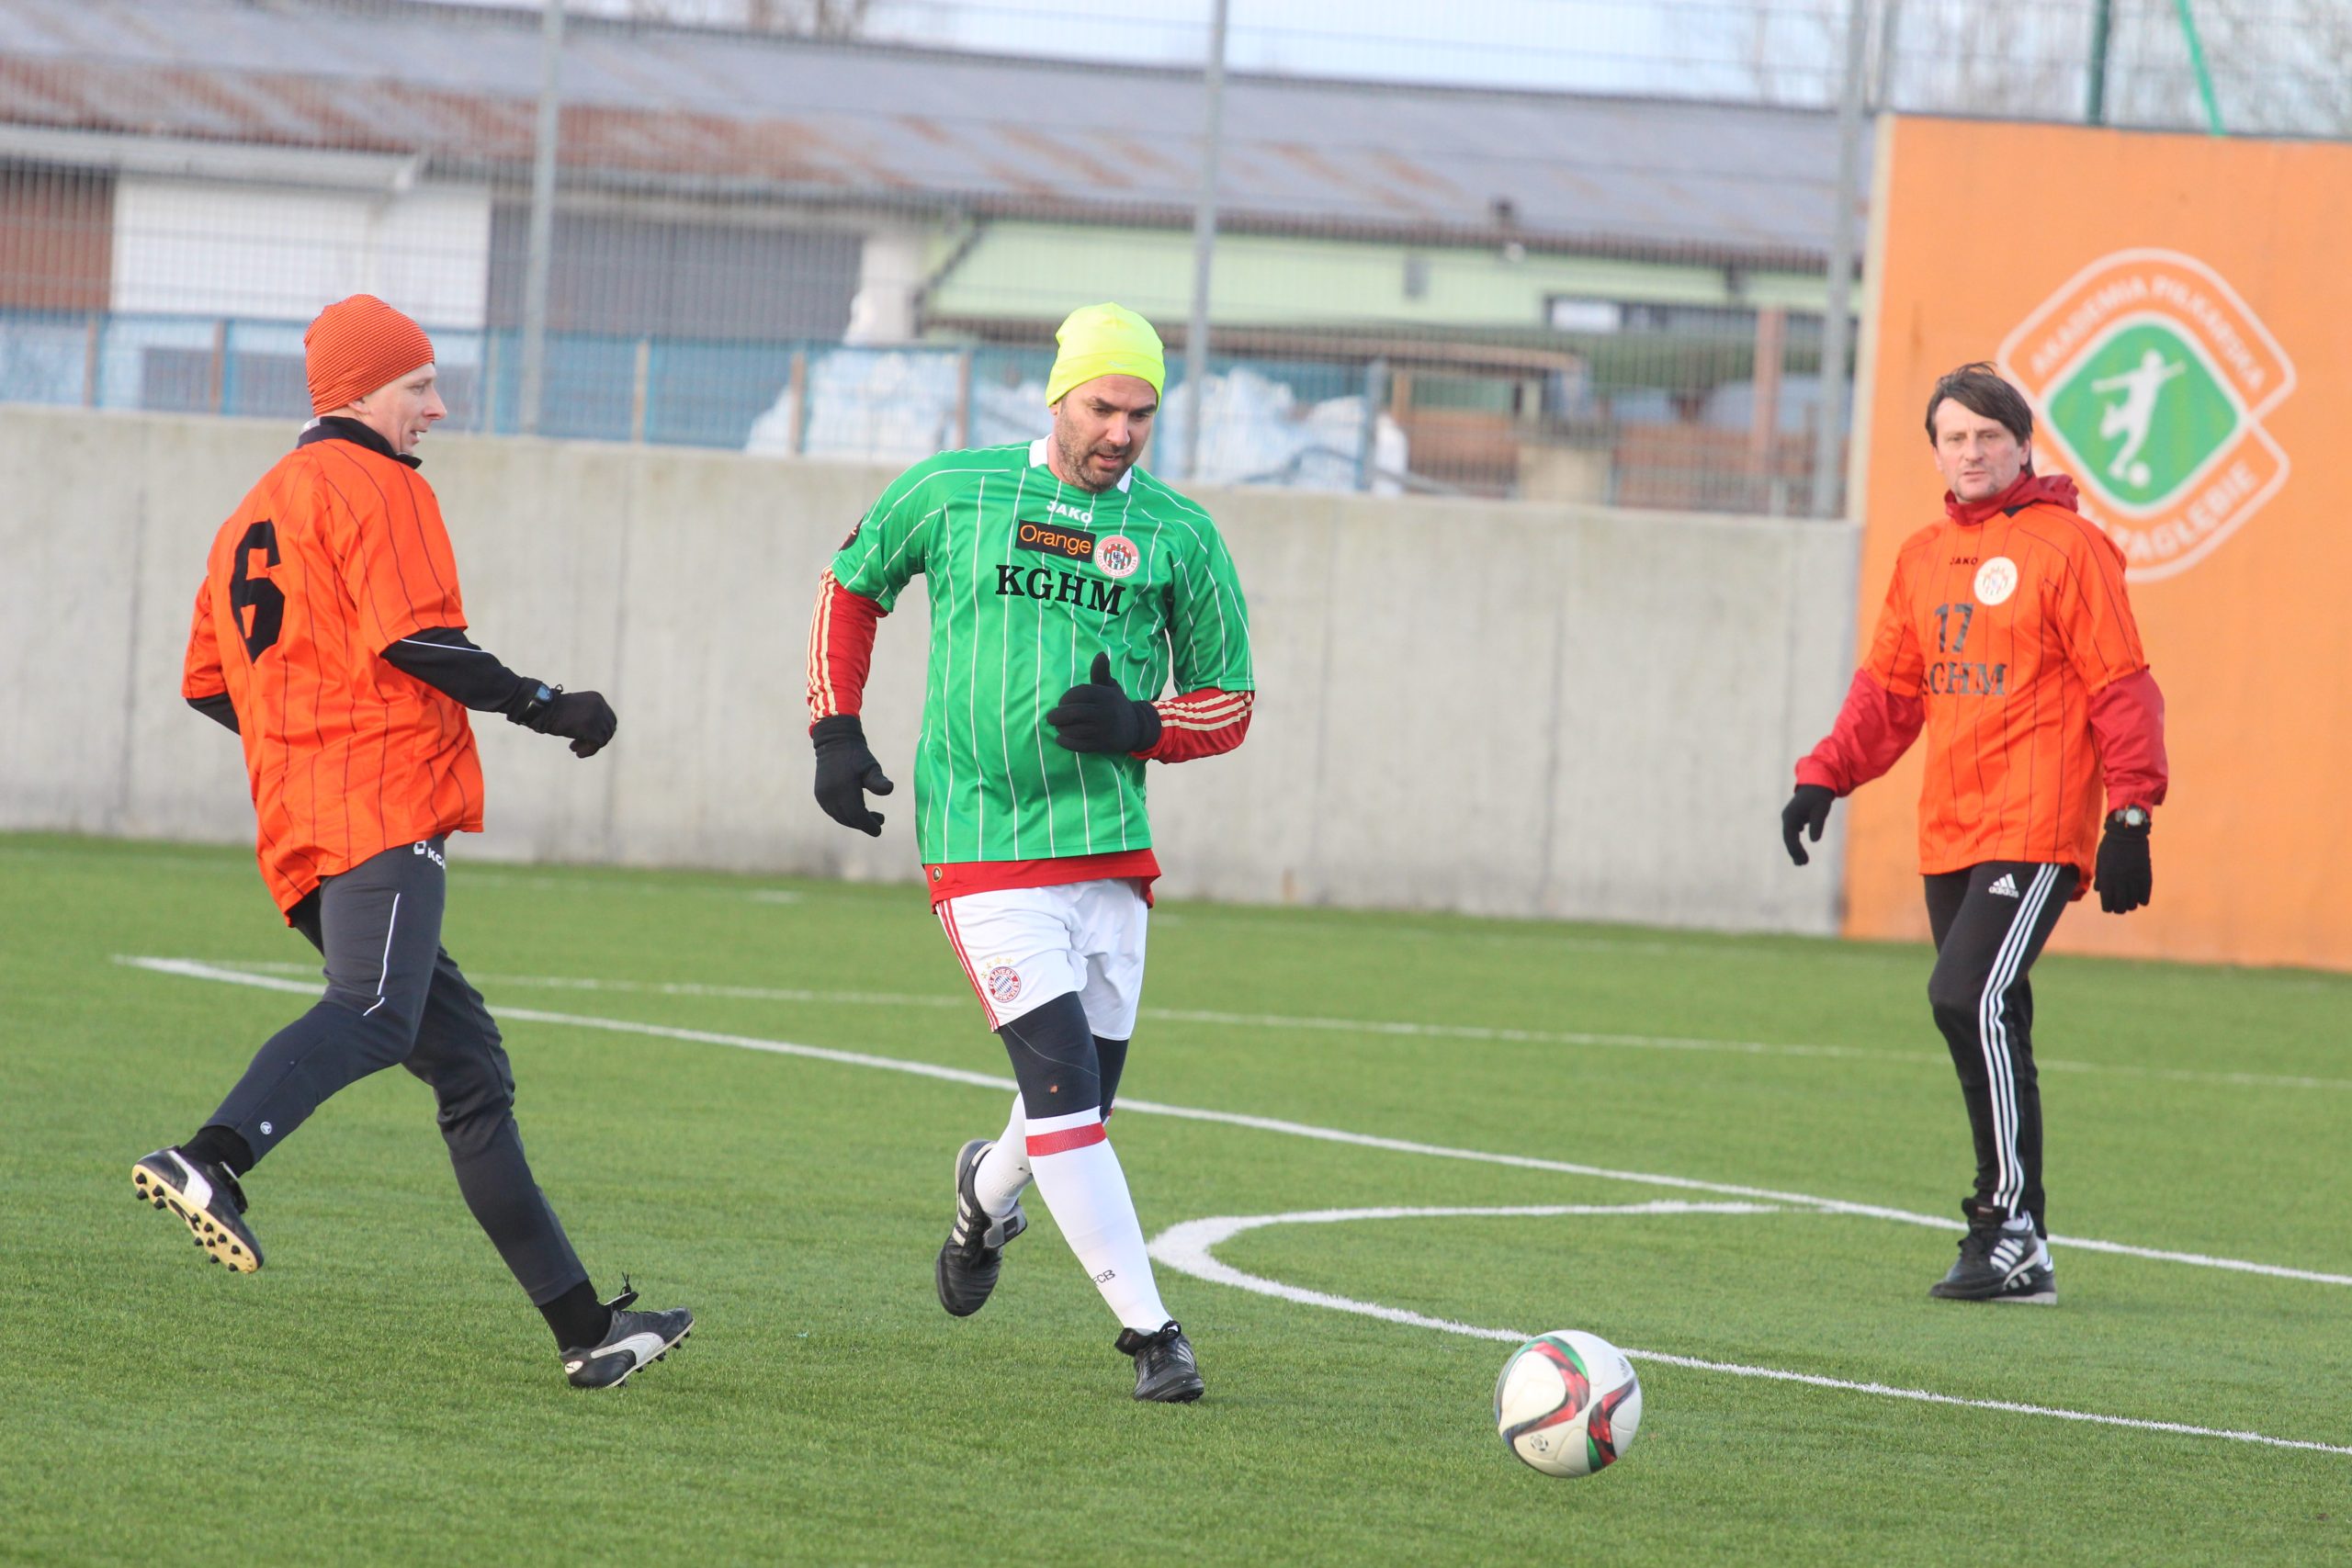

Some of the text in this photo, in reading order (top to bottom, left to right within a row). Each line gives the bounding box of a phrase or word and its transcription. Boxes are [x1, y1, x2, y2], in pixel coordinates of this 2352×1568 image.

[2030, 276, 2148, 376] AKADEMIA
[1046, 501, 1092, 524] JAKO
[1020, 525, 1091, 555] Orange
[1950, 557, 1978, 566] JAKO
[229, 518, 286, 666] 6
[995, 564, 1126, 616] KGHM
[1934, 603, 1974, 653] 17
[427, 847, 446, 870] KG
[1988, 885, 2019, 898] adidas
[990, 968, 1014, 979] BAYERN
